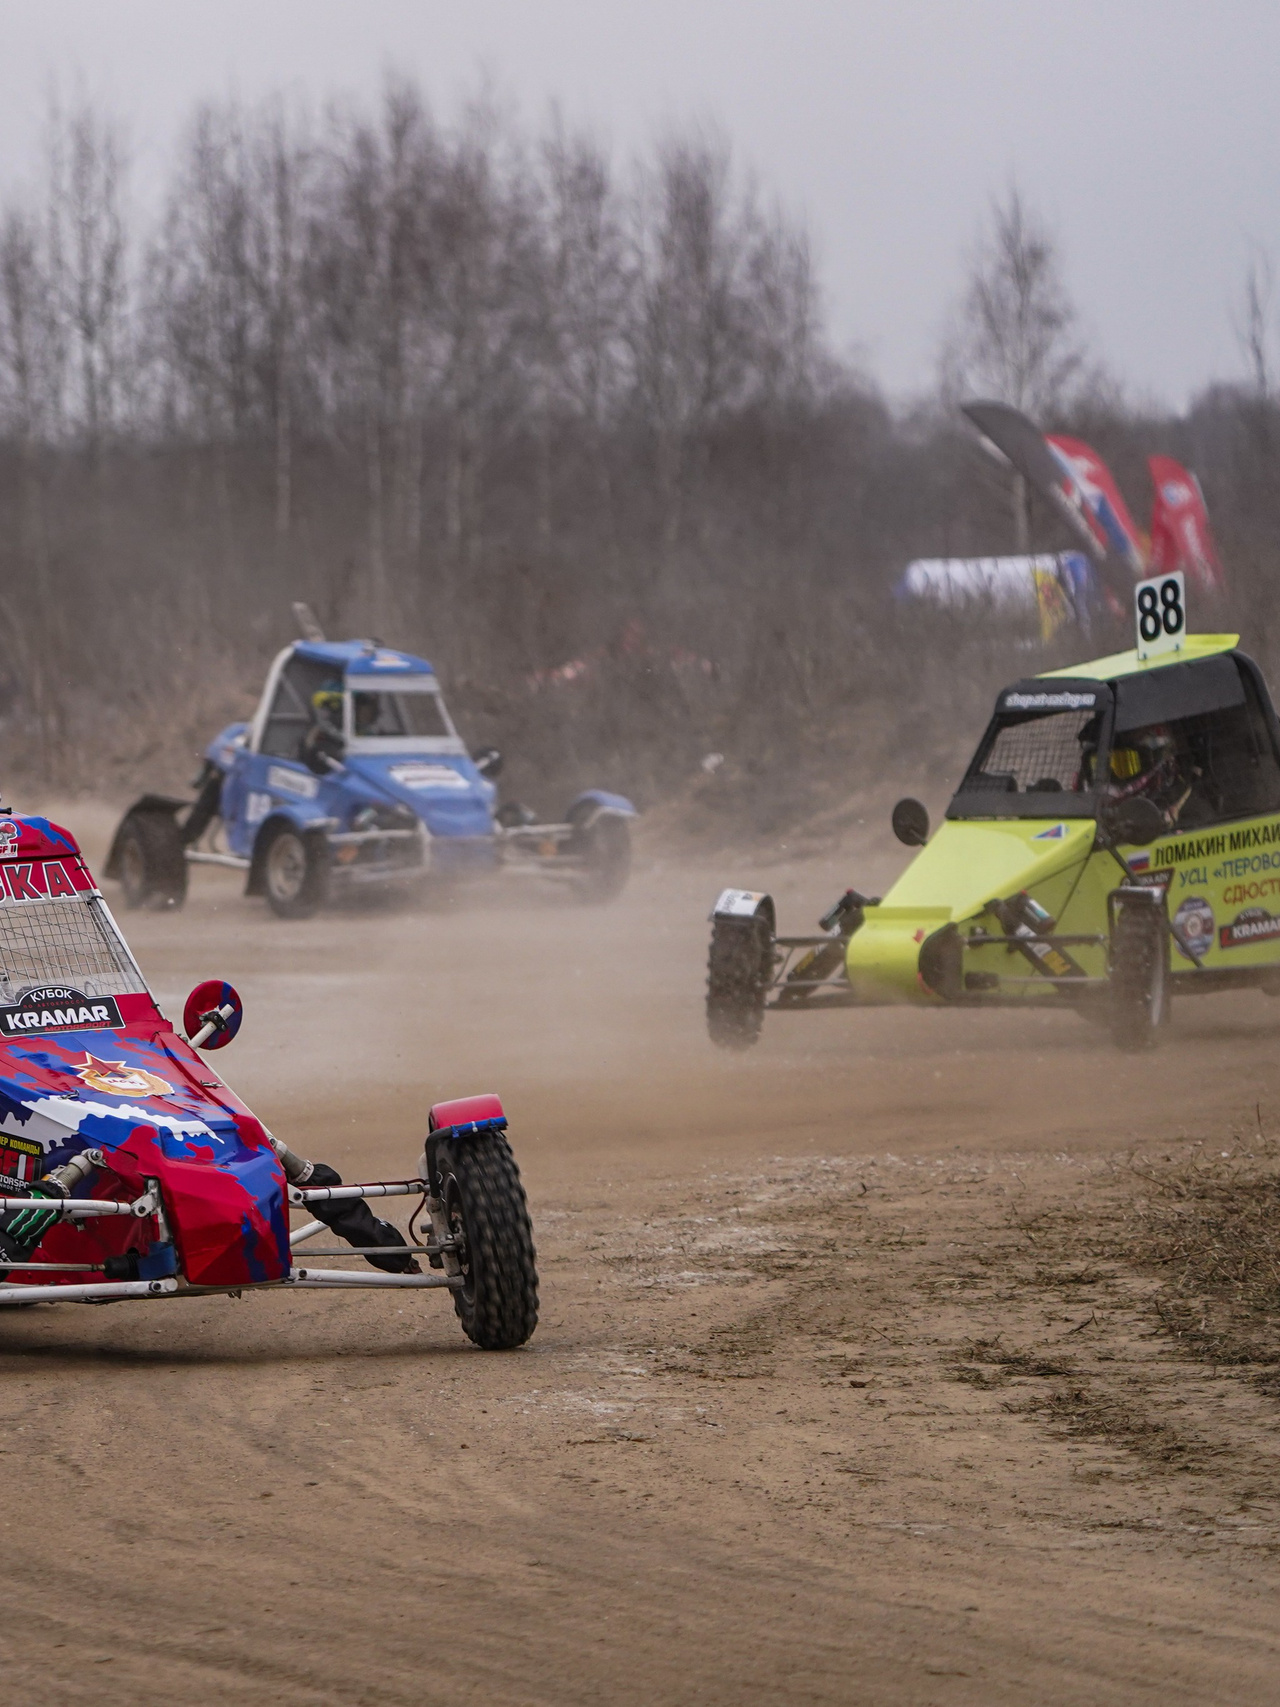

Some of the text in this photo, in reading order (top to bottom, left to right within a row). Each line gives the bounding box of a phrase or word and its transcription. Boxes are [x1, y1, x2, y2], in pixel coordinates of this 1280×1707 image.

[1136, 578, 1185, 642] 88
[1154, 834, 1226, 868] ЛОМАКИН
[1179, 867, 1208, 888] УСЦ
[30, 988, 73, 1003] КУБОК
[6, 1005, 111, 1030] KRAMAR
[44, 1020, 112, 1032] MOTORSPORT
[10, 1139, 41, 1155] КОМАНДЫ
